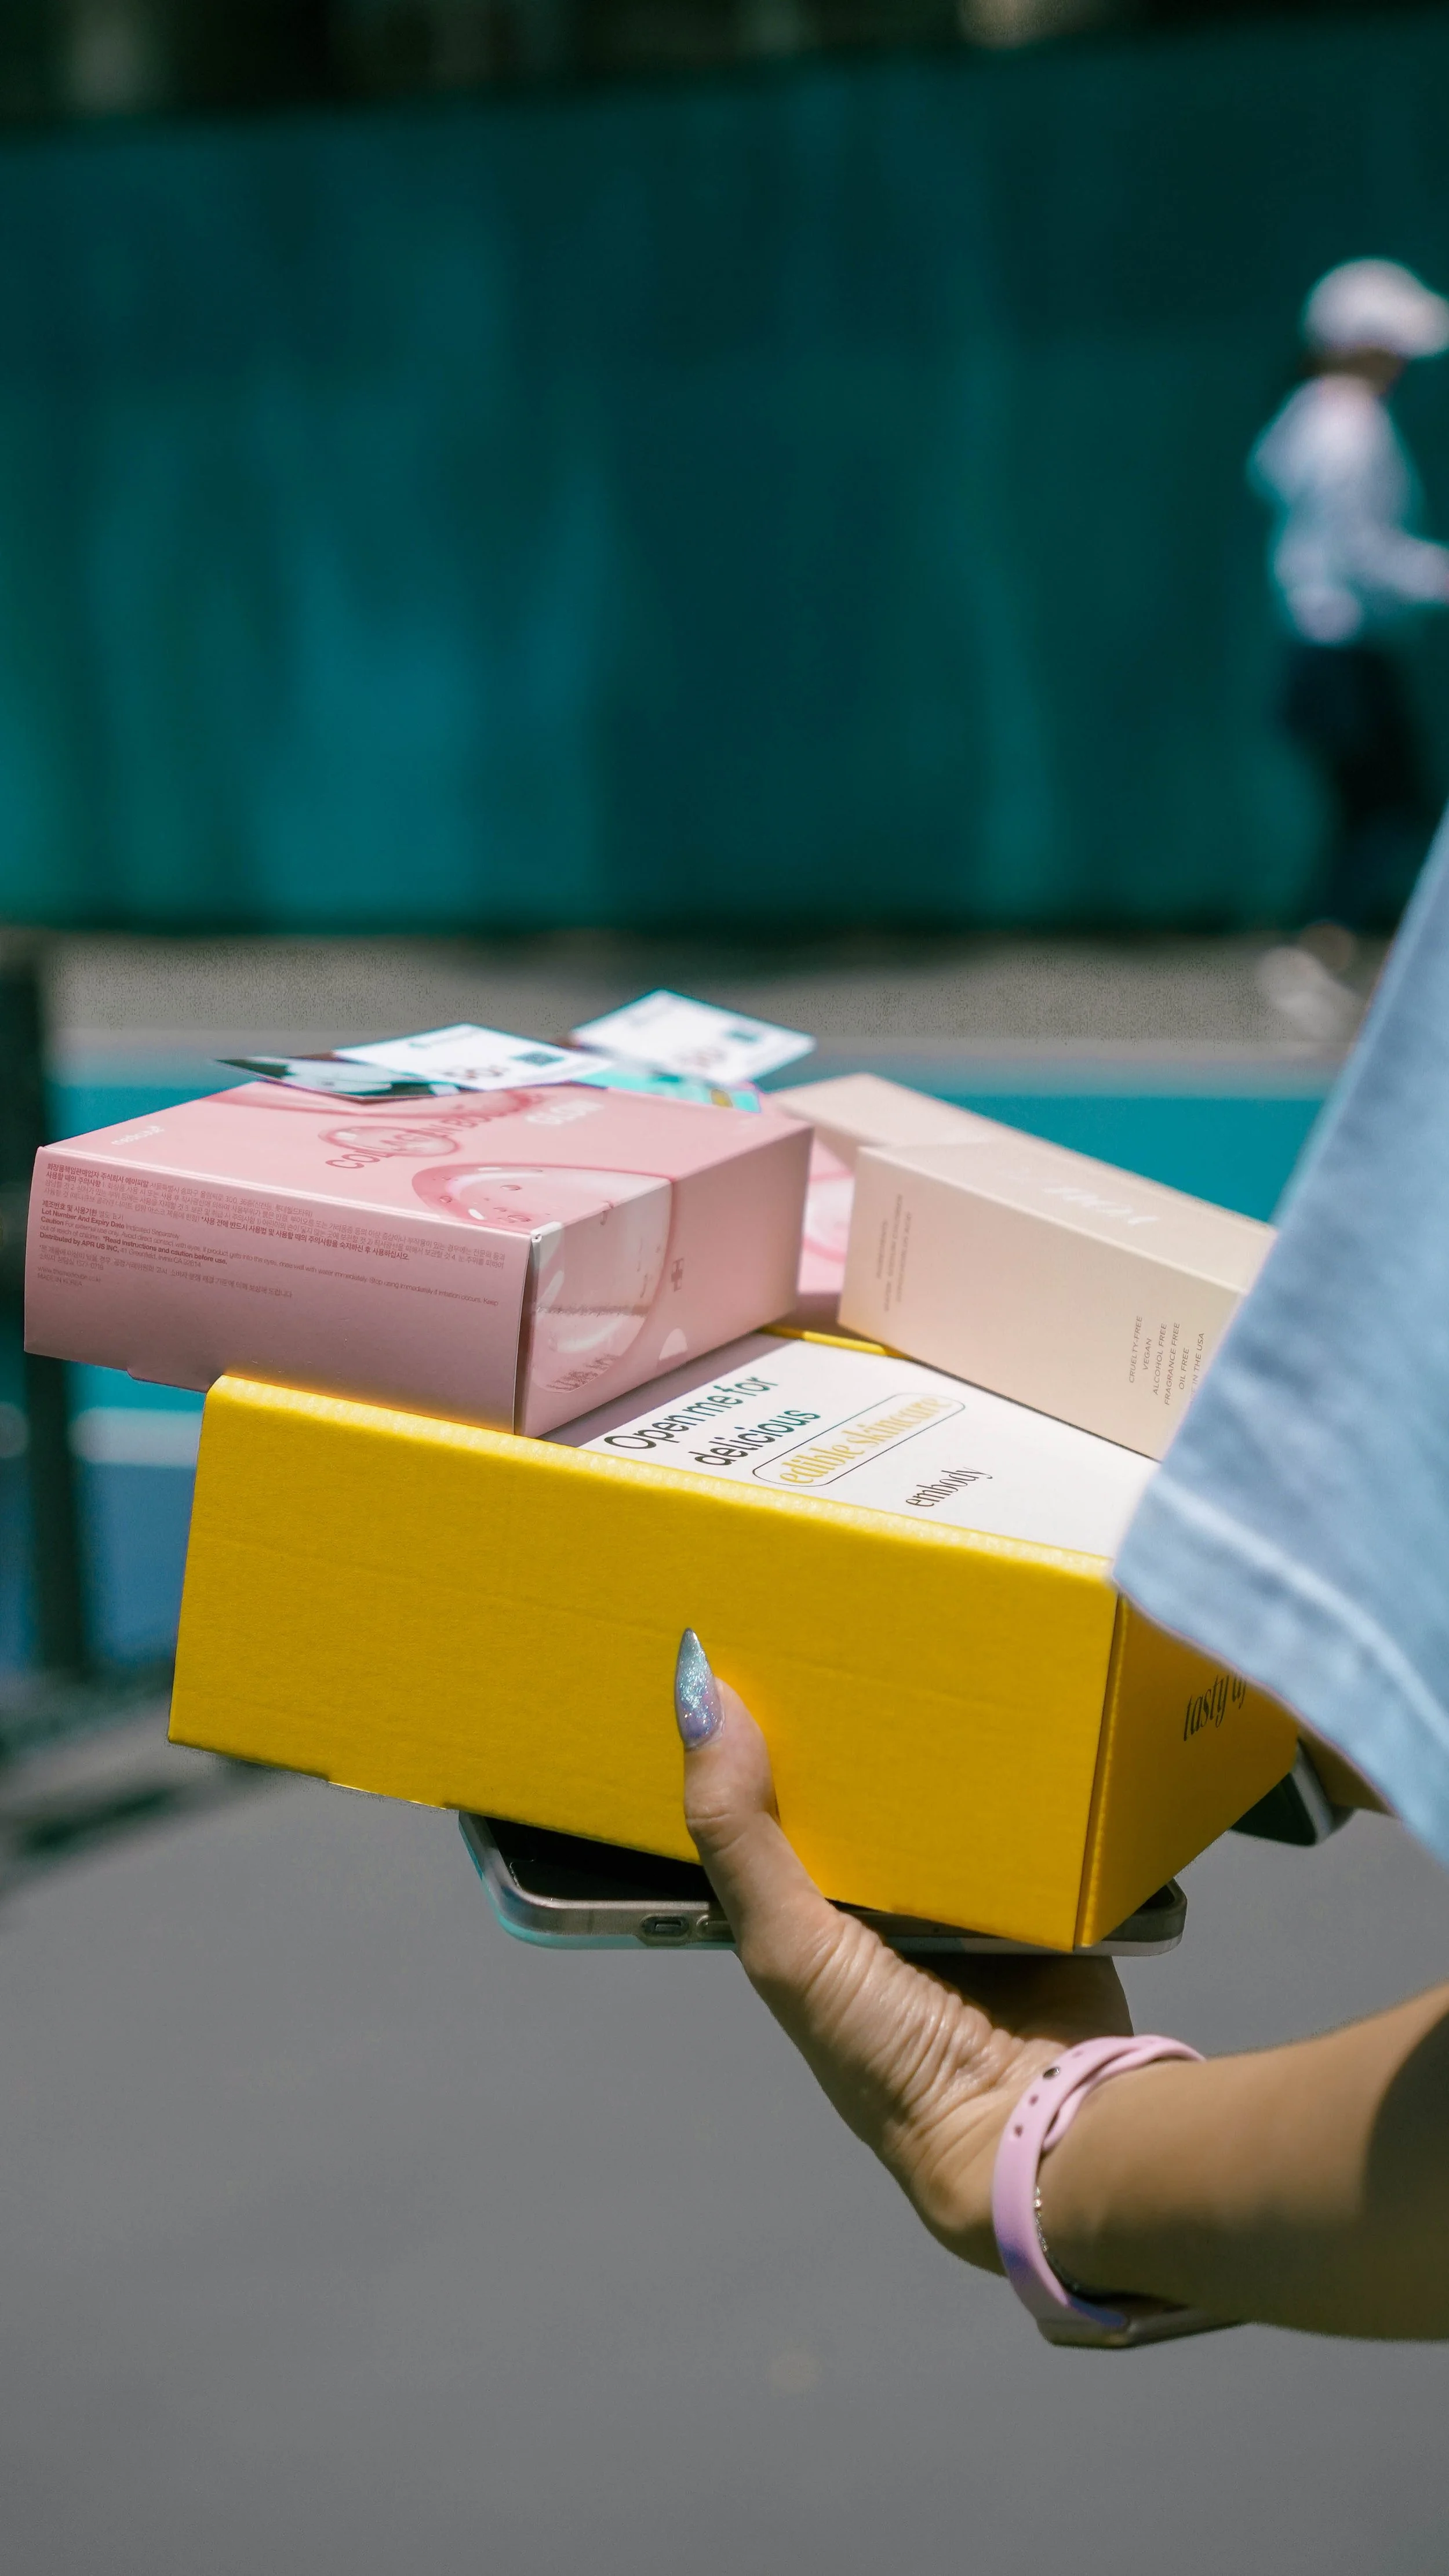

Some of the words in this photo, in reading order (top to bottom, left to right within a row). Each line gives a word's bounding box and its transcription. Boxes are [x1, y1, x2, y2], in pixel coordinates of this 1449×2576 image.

[46, 1171, 63, 1181] 사용할
[64, 1174, 76, 1183] 때의
[78, 1177, 101, 1188] 주의사항
[101, 1172, 123, 1184] 주식회사
[41, 1208, 52, 1216] Lot
[52, 1210, 77, 1221] Number
[77, 1215, 89, 1223] And
[91, 1217, 109, 1227] Expiry
[111, 1221, 124, 1229] Date
[42, 1200, 65, 1211] 제조번호
[74, 1206, 97, 1216] 사용기한
[39, 1232, 71, 1244] Distributed
[81, 1240, 94, 1248] APR
[56, 1228, 73, 1236] reach
[122, 1240, 156, 1251] instructions
[170, 1249, 192, 1258] caution
[194, 1253, 213, 1262] before
[230, 1221, 247, 1231] 반드시
[249, 1225, 267, 1235] 사용법
[268, 1228, 274, 1236] 및
[275, 1229, 293, 1239] 사용할
[294, 1233, 306, 1242] 때의
[308, 1235, 338, 1247] 주의사항을
[339, 1241, 363, 1252] 숙지하신
[364, 1246, 370, 1254] 후
[41, 1217, 63, 1226] Caution
[121, 1231, 136, 1239] Avoid
[136, 1234, 152, 1242] direct
[207, 1247, 228, 1256] product
[483, 1297, 498, 1305] Keep
[62, 1278, 82, 1286] KOREA
[1129, 1316, 1142, 1383] CRUELTY-FREE
[1142, 1338, 1152, 1370] VEGAN
[1153, 1350, 1163, 1395] ALCOHOL
[1159, 1323, 1167, 1347] FREE
[1164, 1348, 1176, 1405] FRAGRANCE
[1171, 1322, 1180, 1346] FREE
[1181, 1348, 1189, 1371] FREE
[712, 1377, 778, 1396] for
[1192, 1374, 1199, 1385] IN
[682, 1395, 743, 1416] me
[604, 1415, 707, 1450] Open
[688, 1410, 821, 1466] delicious
[780, 1445, 865, 1484] edible
[842, 1397, 952, 1447] skincare
[905, 1467, 993, 1507] embody
[1184, 1674, 1229, 1742] tasty
